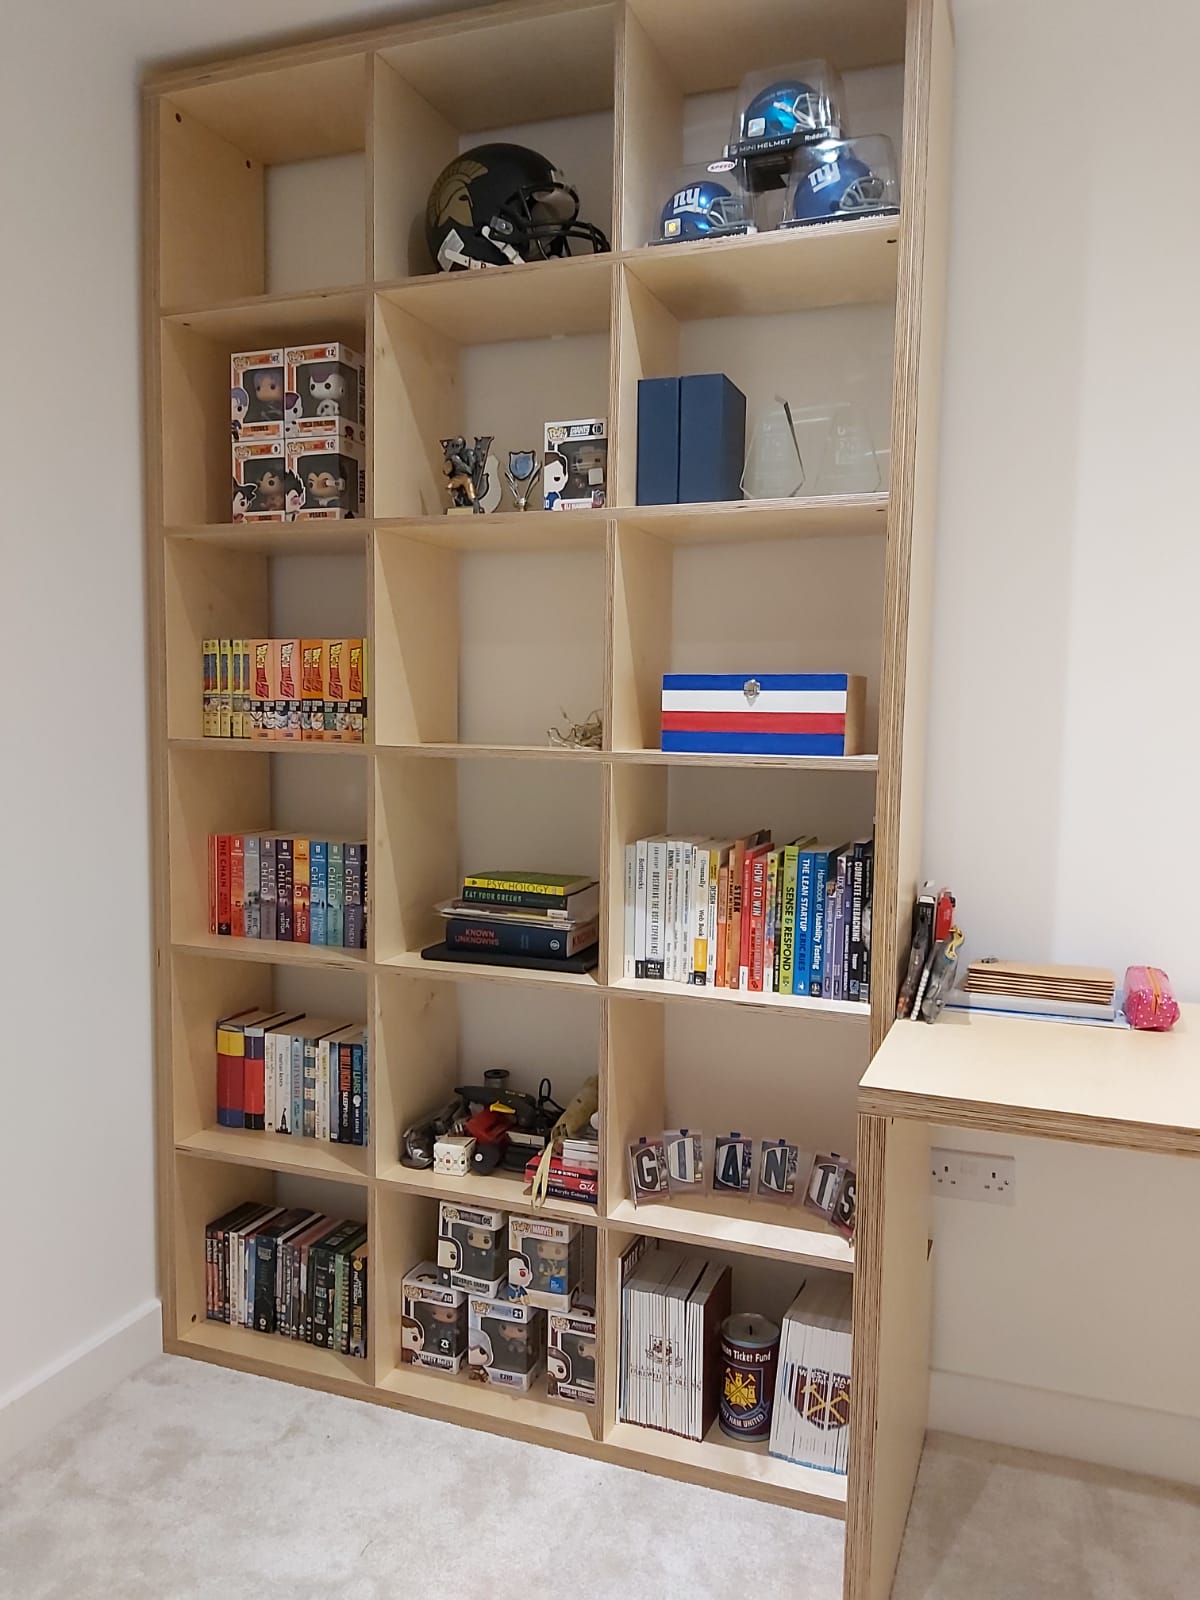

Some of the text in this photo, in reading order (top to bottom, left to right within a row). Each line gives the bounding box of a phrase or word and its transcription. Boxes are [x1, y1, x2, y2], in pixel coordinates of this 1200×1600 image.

[739, 138, 792, 153] MINI HELMET
[710, 162, 734, 170] SPEED
[802, 859, 810, 874] THE
[487, 880, 549, 893] PSYCHOLOGY
[652, 872, 660, 898] OBSERVING
[752, 863, 763, 916] HOW TO WIN
[801, 876, 809, 896] LEAN
[817, 869, 825, 902] Handbook
[479, 892, 495, 900] YOUR
[785, 887, 795, 916] SENSE
[835, 876, 845, 919] UX Research
[852, 861, 863, 942] COMPLETE LINEBACKING
[800, 898, 808, 931] STARTUP
[465, 928, 495, 937] KNOWN
[814, 912, 823, 942] Usability
[455, 935, 499, 945] UNKNOWNS
[650, 925, 658, 955] EXPERIENCE
[782, 926, 793, 971] RESPOND
[798, 953, 806, 971] RIES
[812, 944, 822, 969] Testing
[353, 1072, 361, 1094] LIARS
[532, 1225, 552, 1236] MARVEL
[514, 1310, 523, 1318] 21
[733, 1350, 753, 1362] Ticket
[755, 1351, 771, 1362] Fund
[798, 1368, 829, 1378] WEST
[729, 1415, 764, 1428] HAM UNITED
